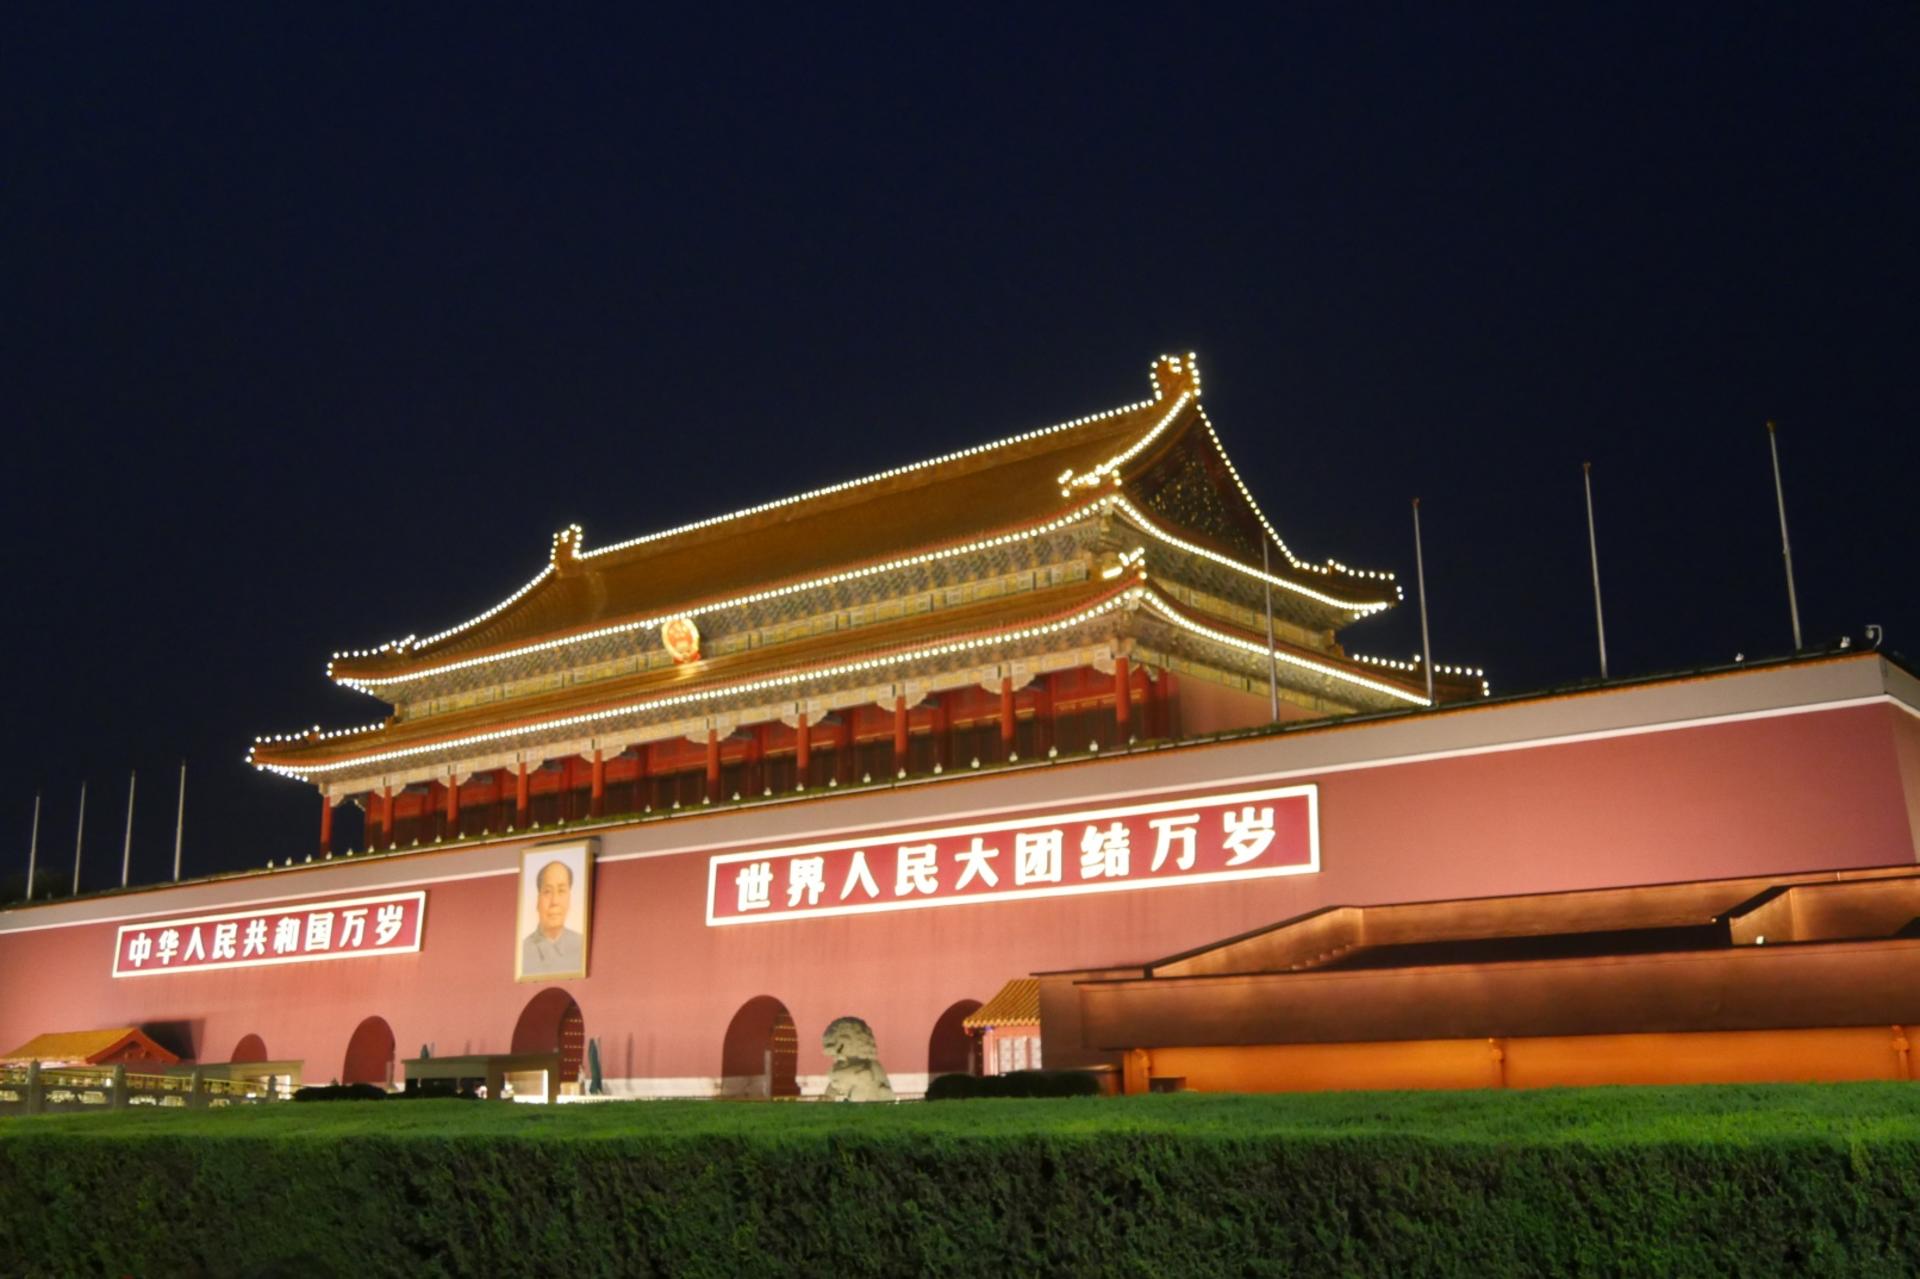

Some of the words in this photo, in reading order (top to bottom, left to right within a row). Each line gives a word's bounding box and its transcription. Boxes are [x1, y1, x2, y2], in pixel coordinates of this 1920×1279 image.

[735, 806, 1276, 912] 世界人民大团结万岁
[128, 904, 404, 967] 中华人民共和国万岁
